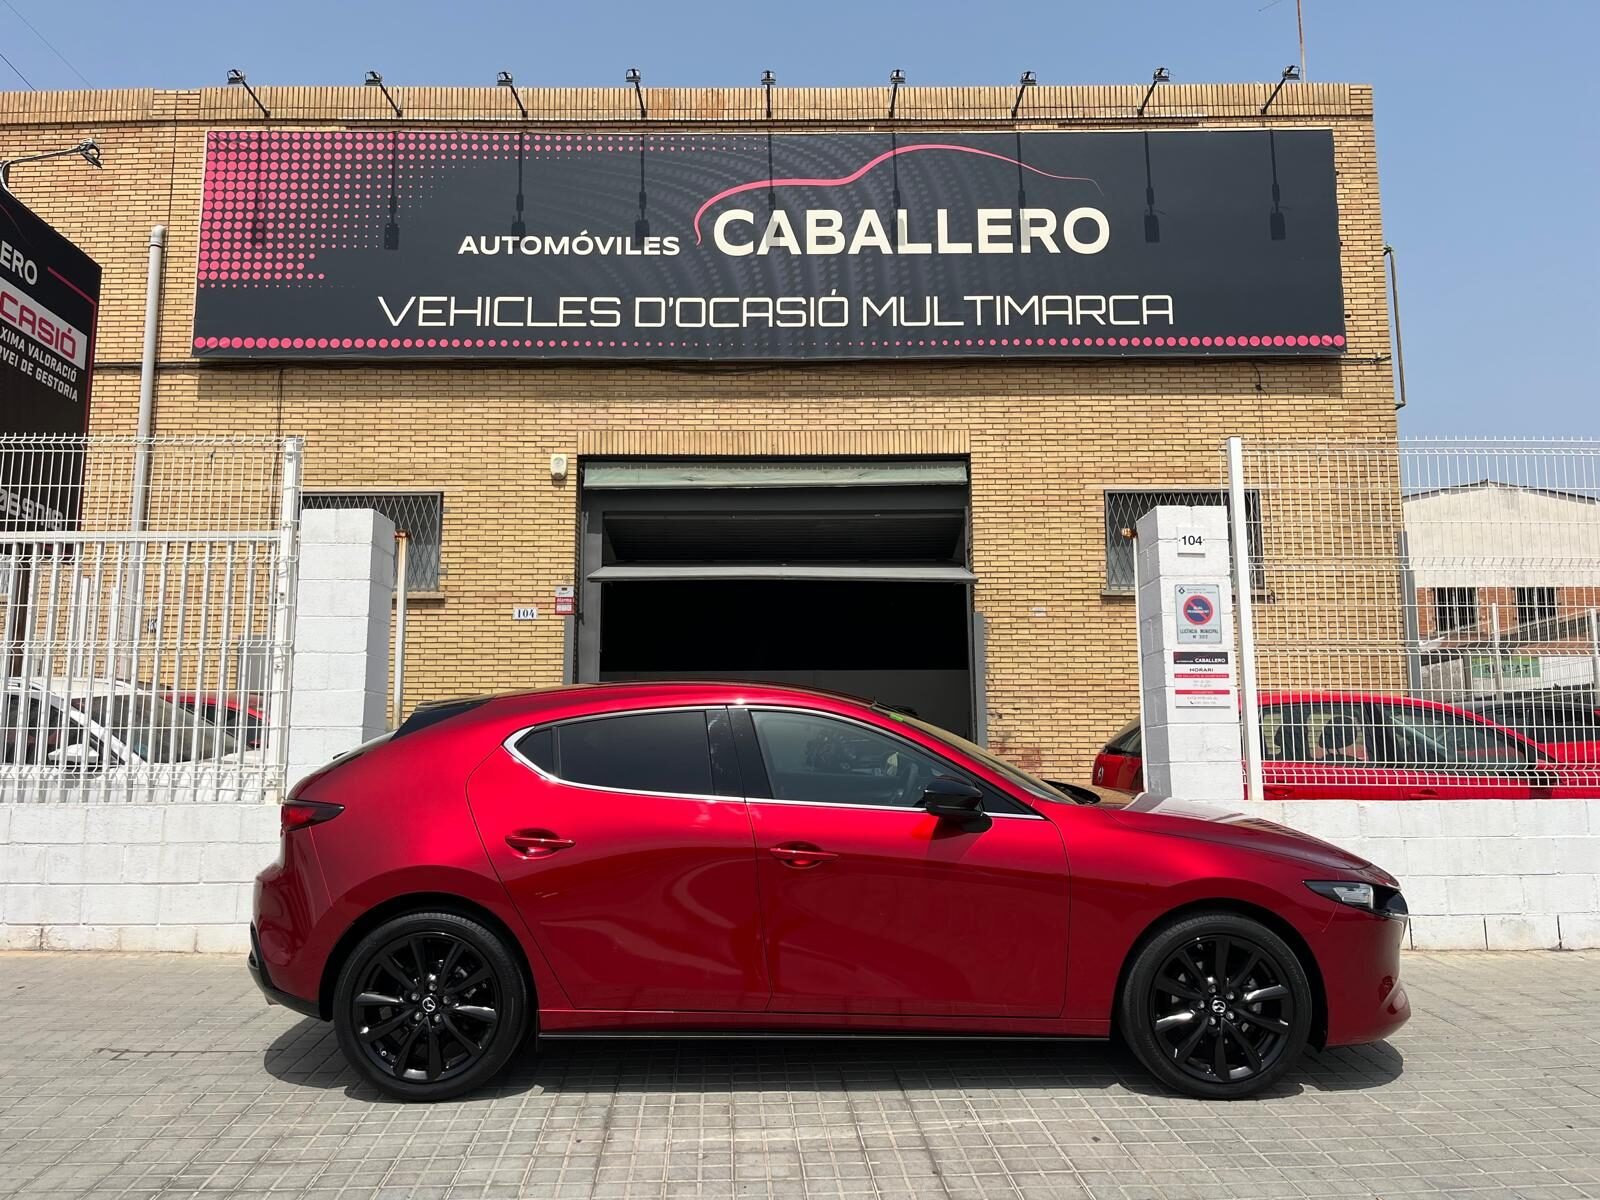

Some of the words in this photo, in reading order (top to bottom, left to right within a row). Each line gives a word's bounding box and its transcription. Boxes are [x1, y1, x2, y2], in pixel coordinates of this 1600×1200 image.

[458, 230, 680, 256] AUTOMÓVILES
[713, 206, 1110, 256] CABALLERO
[377, 295, 621, 327] VEHICLES
[634, 288, 849, 328] D'OCASIÓ
[20, 359, 33, 377] DE
[35, 367, 78, 403] GESTORIA
[28, 342, 77, 383] VALORACIÓ
[1181, 535, 1203, 546] 104
[517, 609, 535, 618] 104
